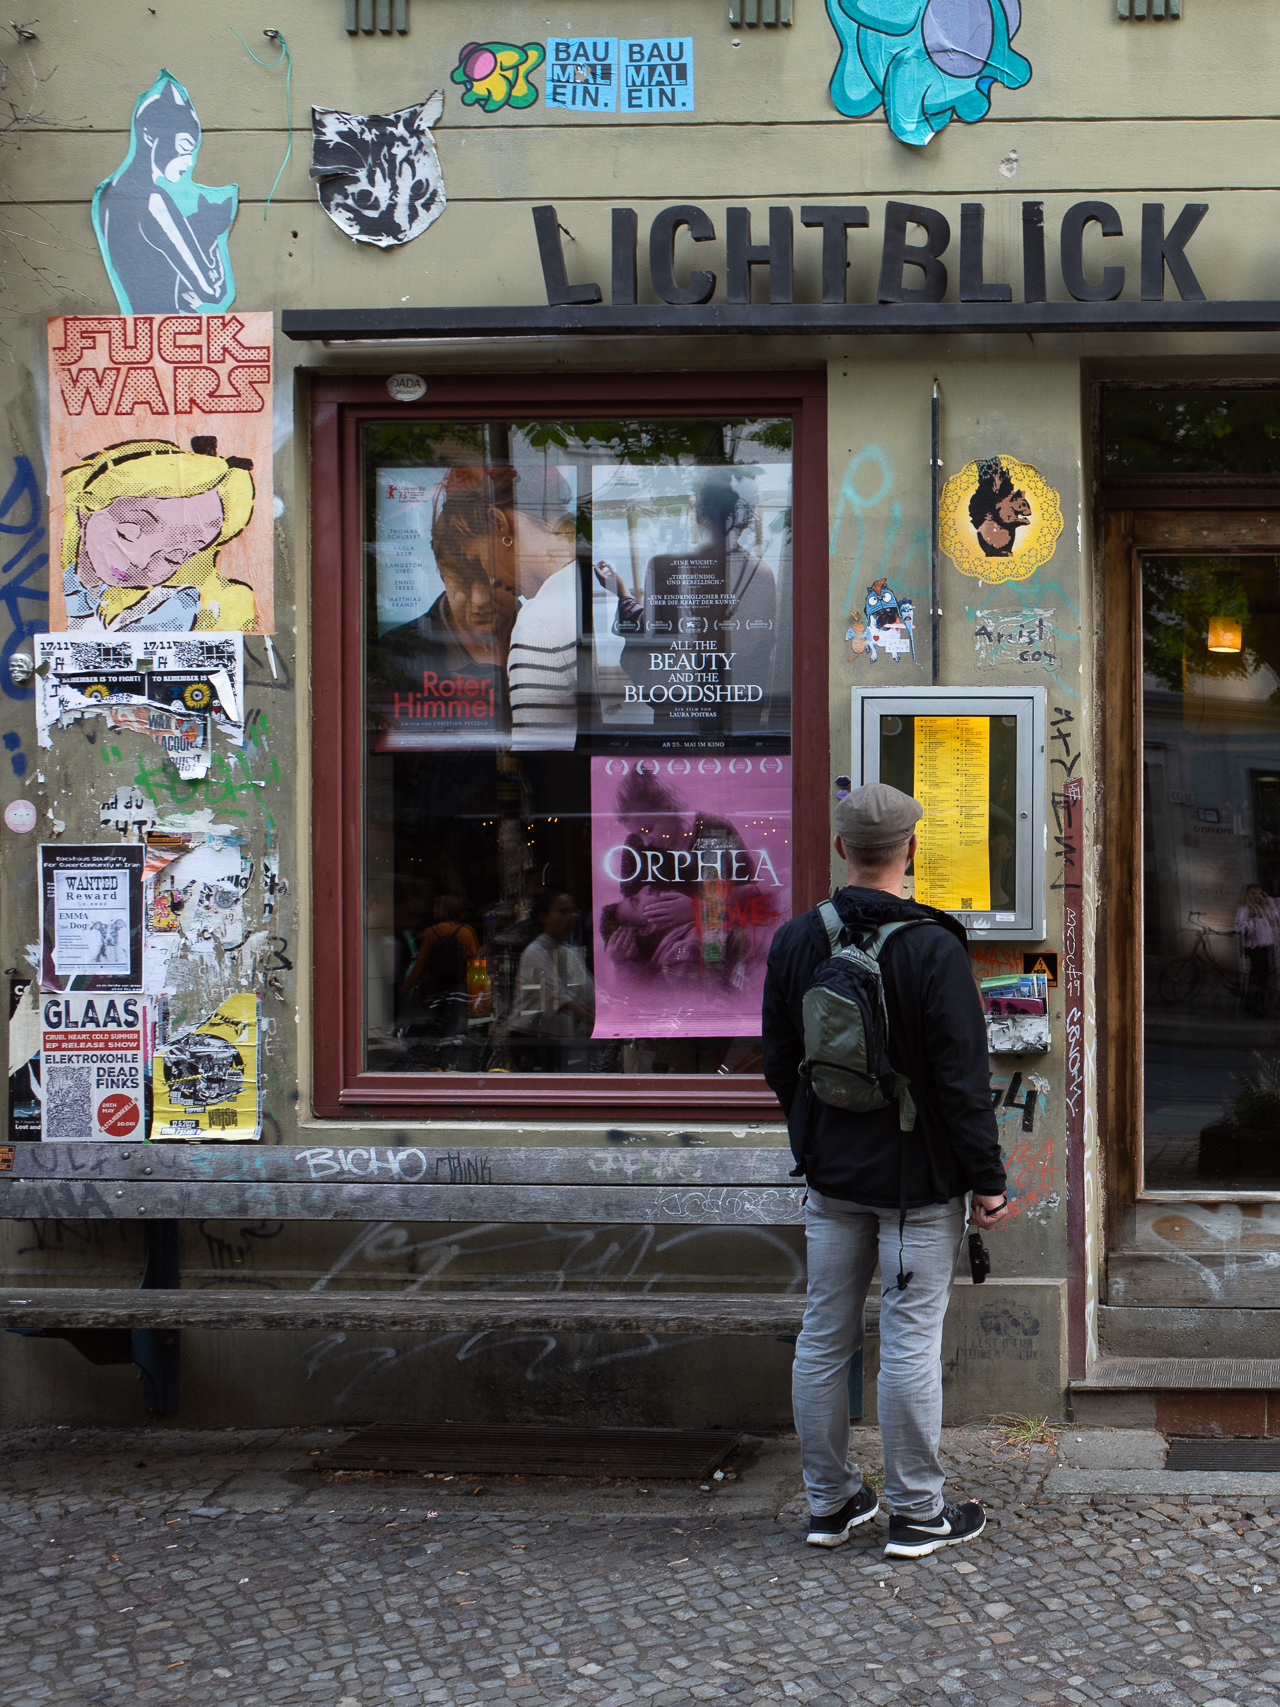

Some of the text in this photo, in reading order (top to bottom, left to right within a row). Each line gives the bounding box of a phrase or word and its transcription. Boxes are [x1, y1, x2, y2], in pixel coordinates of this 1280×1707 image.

[555, 42, 609, 62] BAU
[629, 42, 684, 63] BAU
[627, 65, 687, 87] MAL
[552, 84, 609, 108] EIN.
[628, 88, 687, 109] EIN.
[532, 200, 1209, 306] LICHTBLICK
[53, 315, 271, 366] FUCK
[59, 366, 272, 416] WARS
[669, 640, 718, 650] ALL THE
[649, 652, 737, 671] BEAUTY
[423, 671, 493, 697] Roter
[668, 673, 719, 682] AND THE
[623, 684, 763, 703] BLOODSHED
[394, 692, 495, 719] Himmel
[603, 845, 784, 887] ORPHEA
[66, 876, 119, 891] WANTED
[66, 892, 117, 901] Reward
[59, 912, 89, 920] EMMA
[44, 998, 140, 1029] GLAAS
[45, 1054, 139, 1064] ELEKTROKOHLE
[96, 1067, 139, 1078] DEAD
[96, 1078, 140, 1089] FINKS
[295, 1146, 427, 1182] BICHO
